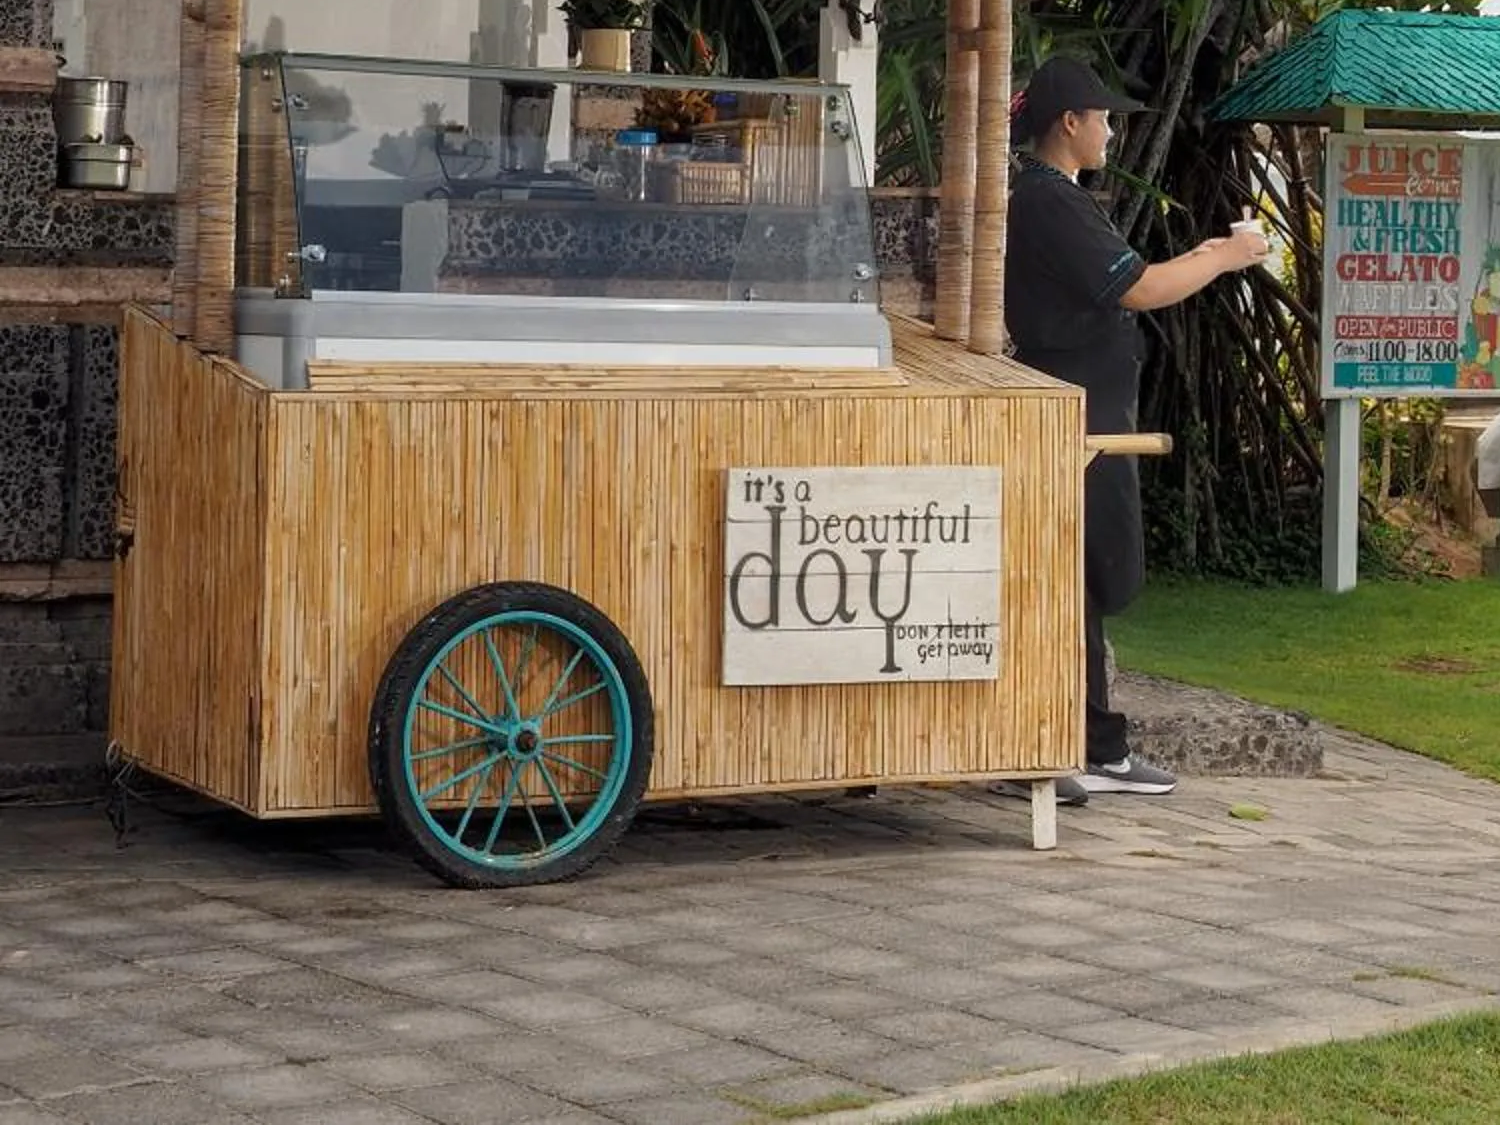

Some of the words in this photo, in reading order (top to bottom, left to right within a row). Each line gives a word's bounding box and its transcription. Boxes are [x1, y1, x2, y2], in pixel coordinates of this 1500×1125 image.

[1339, 142, 1464, 175] JUICE
[1337, 199, 1461, 229] HEALTHY
[1336, 253, 1460, 283] GELATO
[1338, 319, 1377, 337] OPEN
[1398, 320, 1457, 338] PUBLIC
[744, 472, 785, 503] it's
[794, 480, 812, 502] a
[799, 501, 970, 545] beautiful
[729, 505, 920, 673] day
[917, 642, 943, 664] get
[948, 642, 993, 664] away
